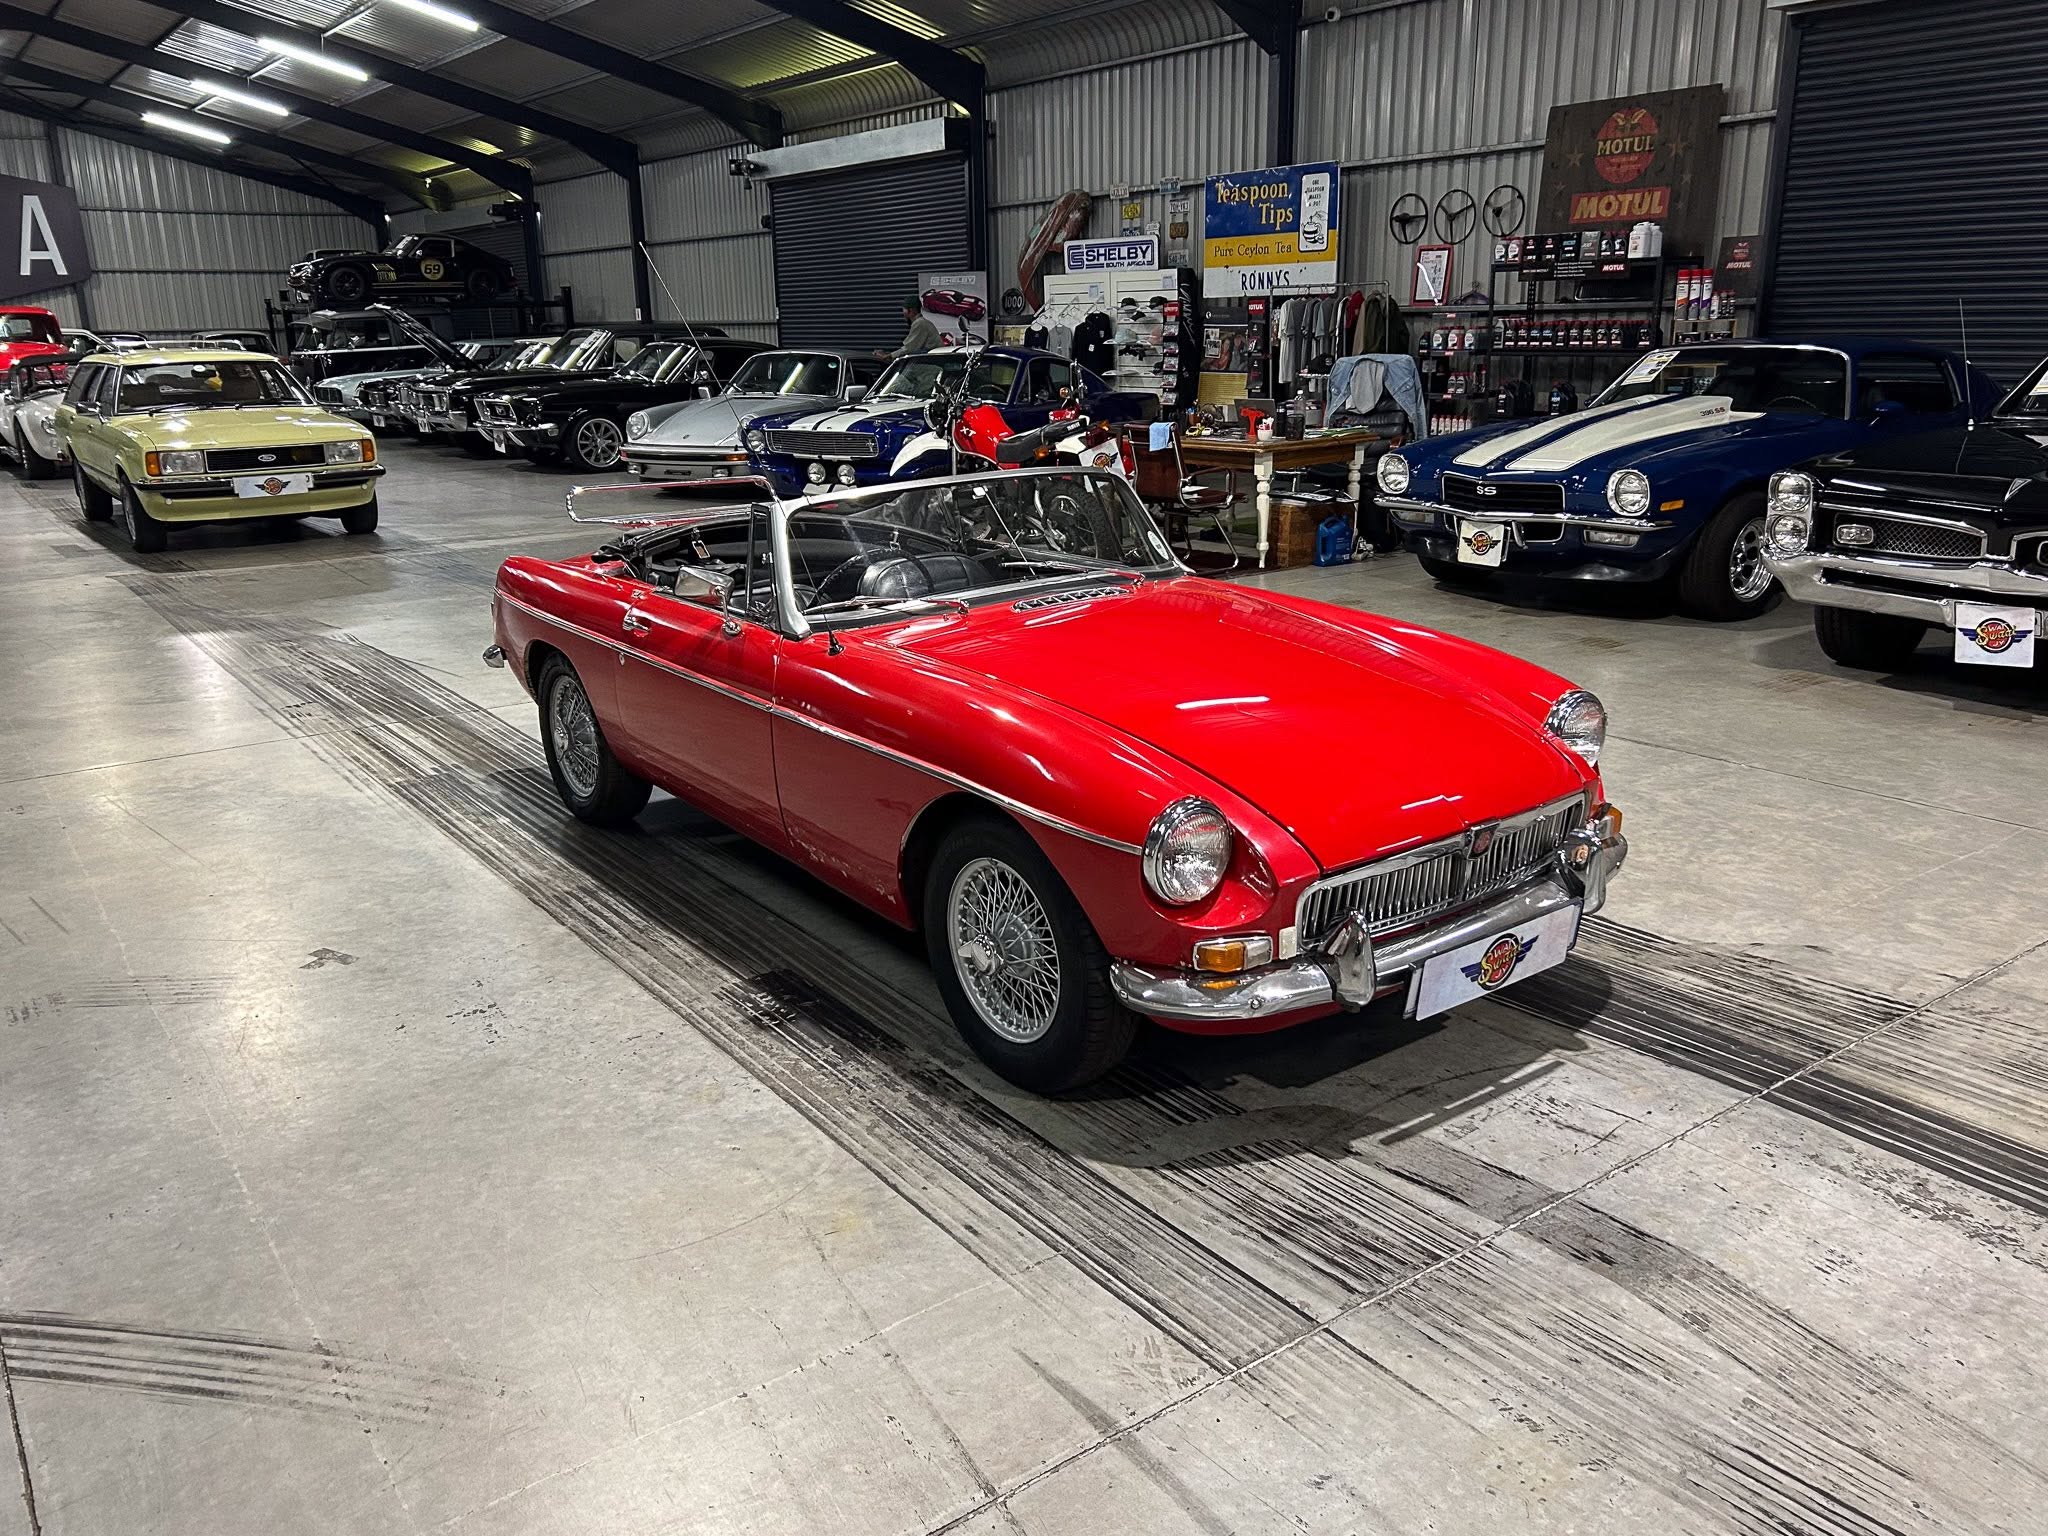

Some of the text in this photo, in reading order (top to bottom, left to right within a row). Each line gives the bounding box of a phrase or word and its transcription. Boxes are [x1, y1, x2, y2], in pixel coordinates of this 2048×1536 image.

[1597, 136, 1654, 156] MOTUL
[1215, 181, 1288, 207] Teaspoon
[1573, 191, 1663, 220] MOTUL
[1258, 203, 1293, 231] Tips
[20, 195, 69, 276] A
[1085, 245, 1151, 263] SHELBY
[1214, 241, 1292, 258] Pure Ceylon Tea
[423, 263, 442, 275] 69
[1602, 264, 1625, 272] MOTUL
[1241, 270, 1291, 291] RONNYS
[959, 426, 977, 437] XT
[1476, 485, 1497, 496] SS
